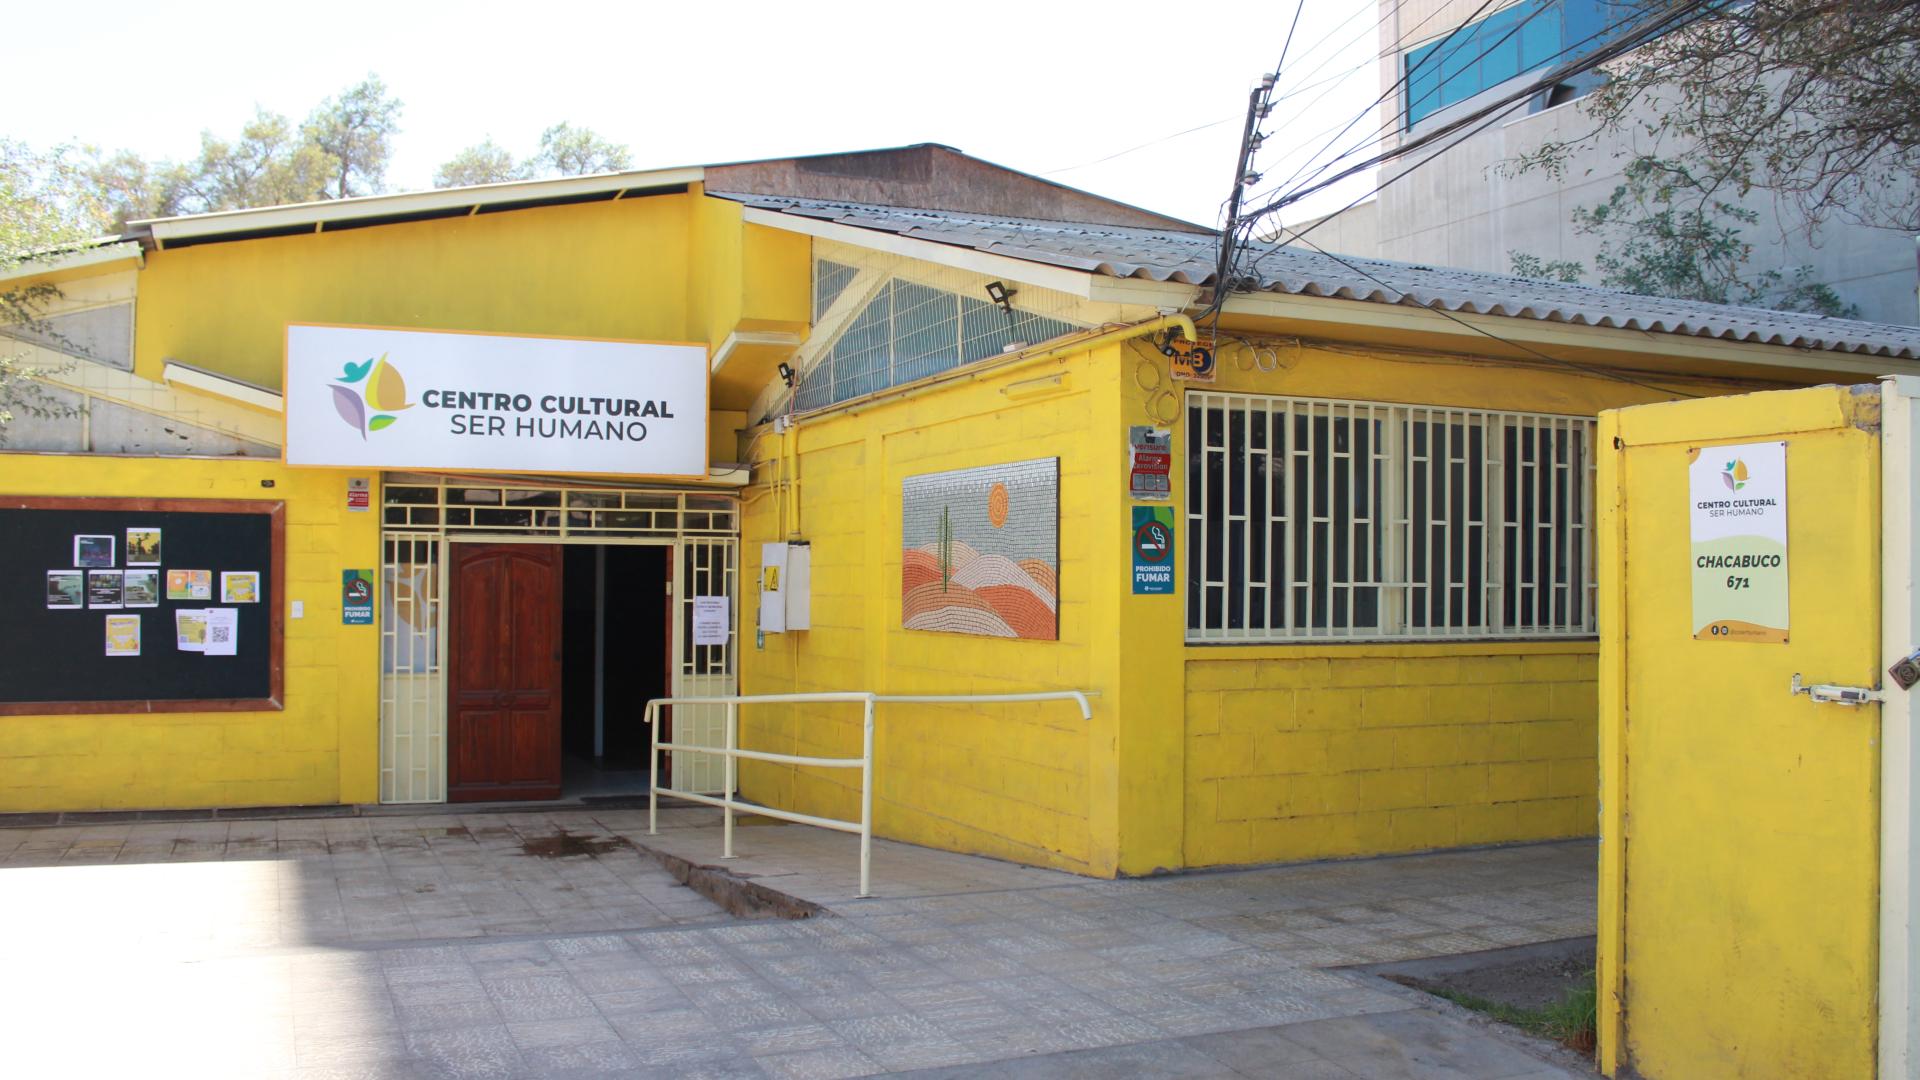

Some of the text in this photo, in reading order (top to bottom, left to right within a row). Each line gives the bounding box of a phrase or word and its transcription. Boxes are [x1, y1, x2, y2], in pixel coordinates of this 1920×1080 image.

[422, 389, 674, 419] CENTRO CULTURAL
[450, 414, 648, 442] SER HUMANO
[1697, 498, 1777, 509] CENTRO CULTURAL
[1709, 507, 1764, 518] SER HUMANO
[1697, 555, 1780, 568] CHACABUCO
[1136, 573, 1170, 582] FUMAR
[1726, 575, 1750, 590] 671
